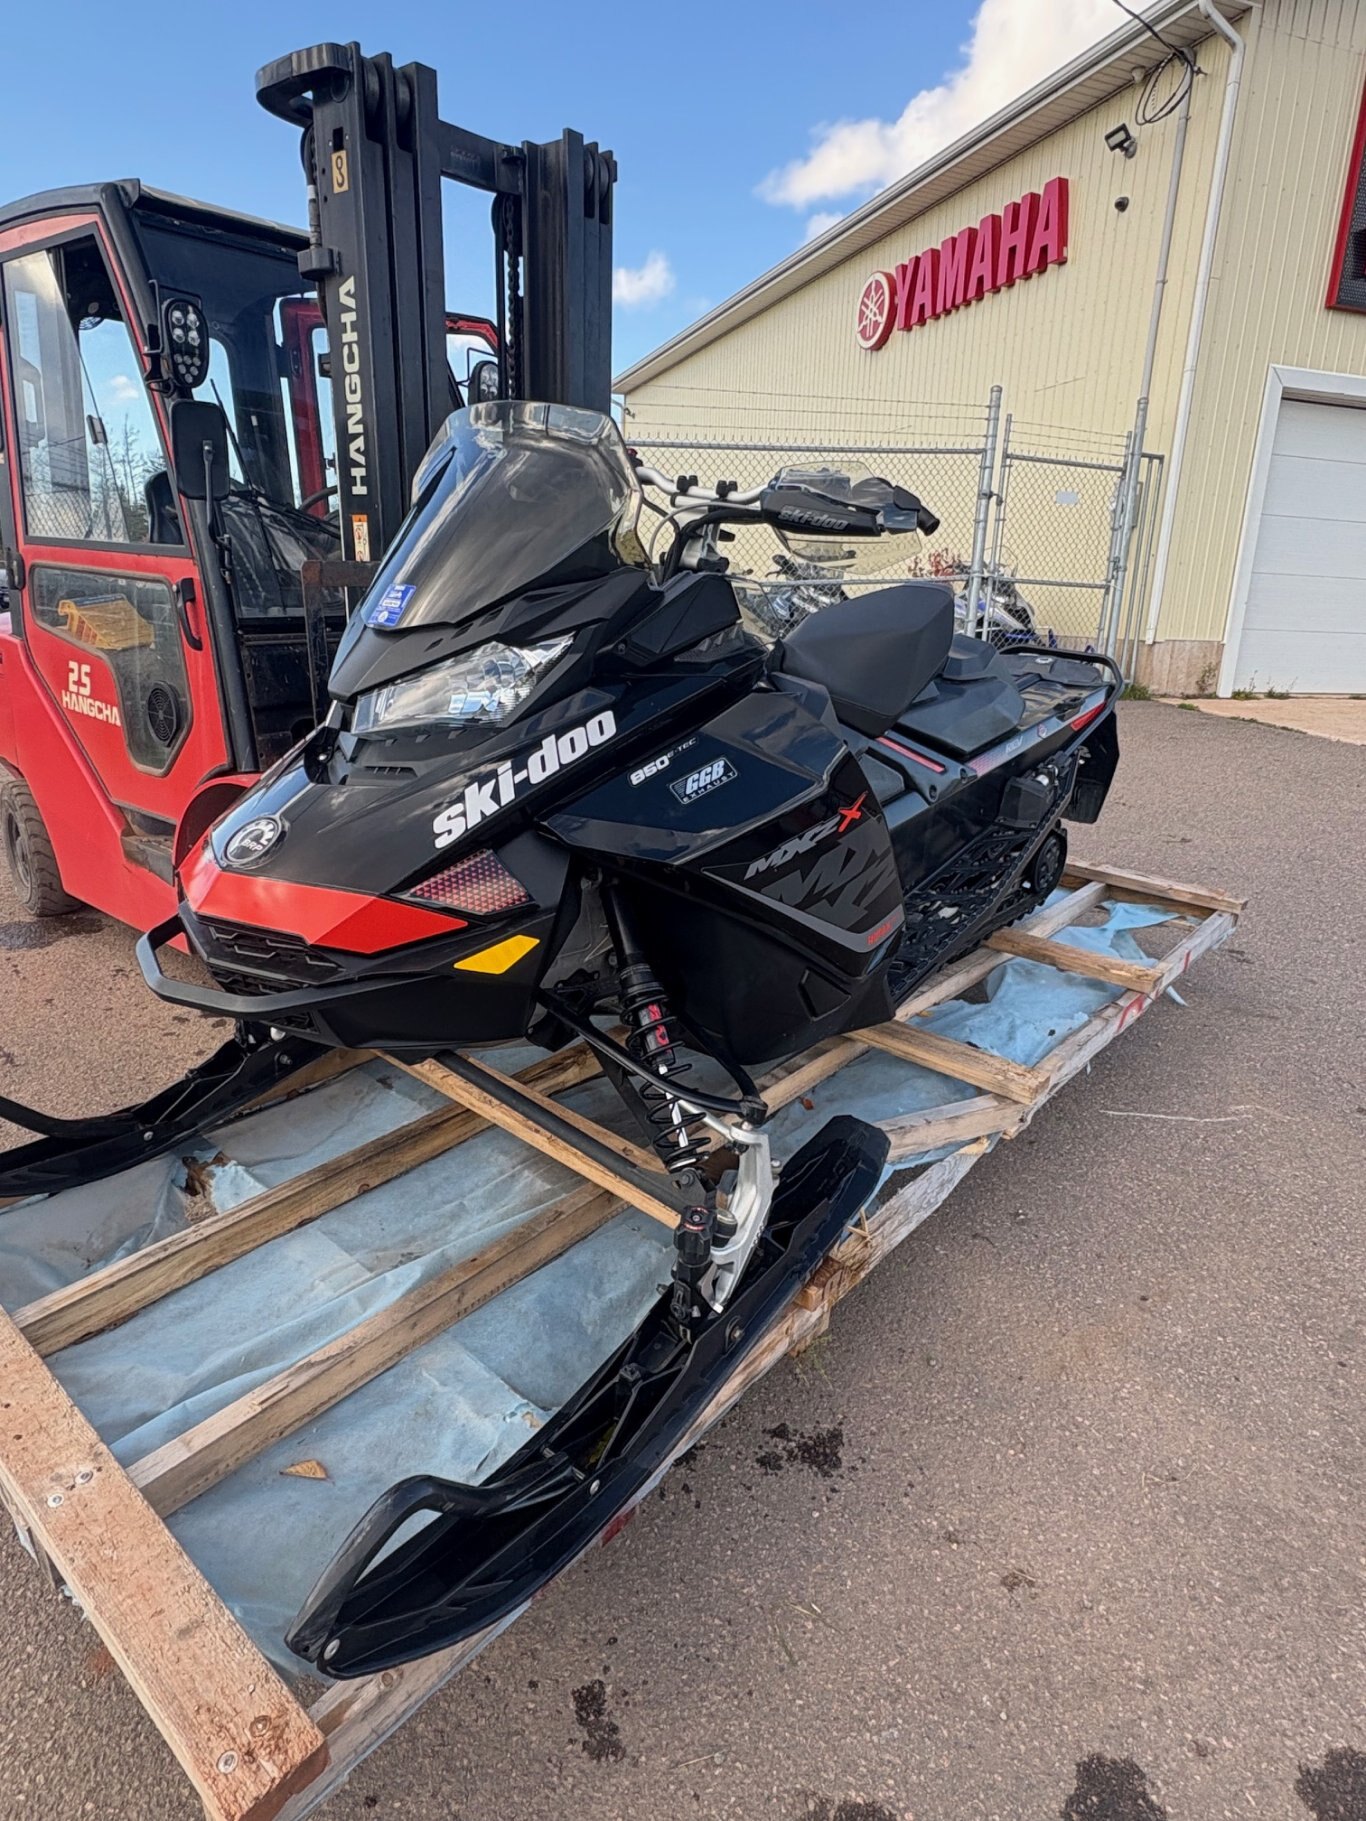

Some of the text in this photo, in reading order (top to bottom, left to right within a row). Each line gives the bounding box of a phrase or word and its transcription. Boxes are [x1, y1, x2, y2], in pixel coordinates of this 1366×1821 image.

[895, 176, 1069, 332] YAMAHA
[338, 275, 368, 496] HANGCHA
[68, 660, 91, 696] 25
[61, 689, 121, 728] HANGCHA
[629, 755, 670, 786] 850
[682, 772, 735, 803] EXHAUST
[685, 760, 725, 795] GGB
[240, 838, 264, 851] BRP
